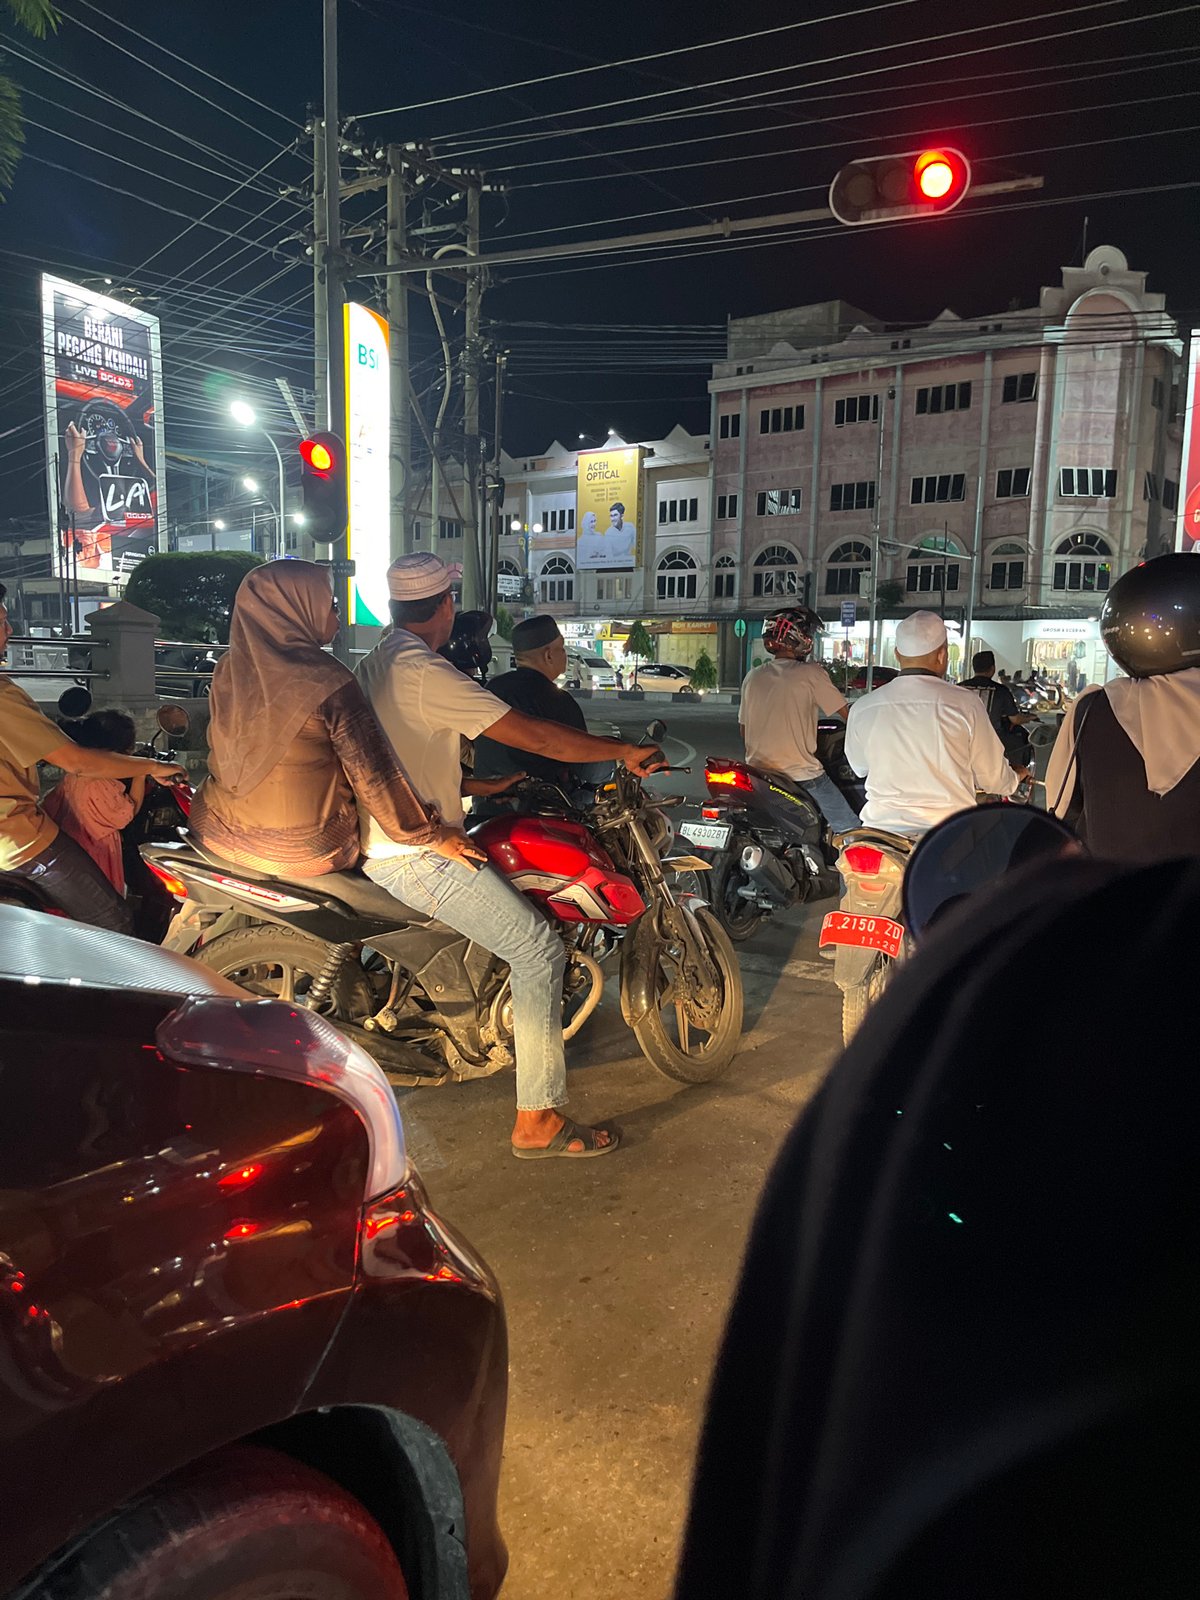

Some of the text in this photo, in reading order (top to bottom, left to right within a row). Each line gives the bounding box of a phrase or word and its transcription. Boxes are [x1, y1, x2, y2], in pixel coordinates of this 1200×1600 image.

[84, 315, 124, 349] BERANI
[57, 331, 148, 380] PEGANG KENDALI
[358, 343, 379, 371] BSI
[75, 364, 126, 385] LIVE BOLD
[586, 469, 620, 481] OPTICAL
[587, 461, 609, 472] ACEH
[823, 915, 901, 939] BL 2150 ZD
